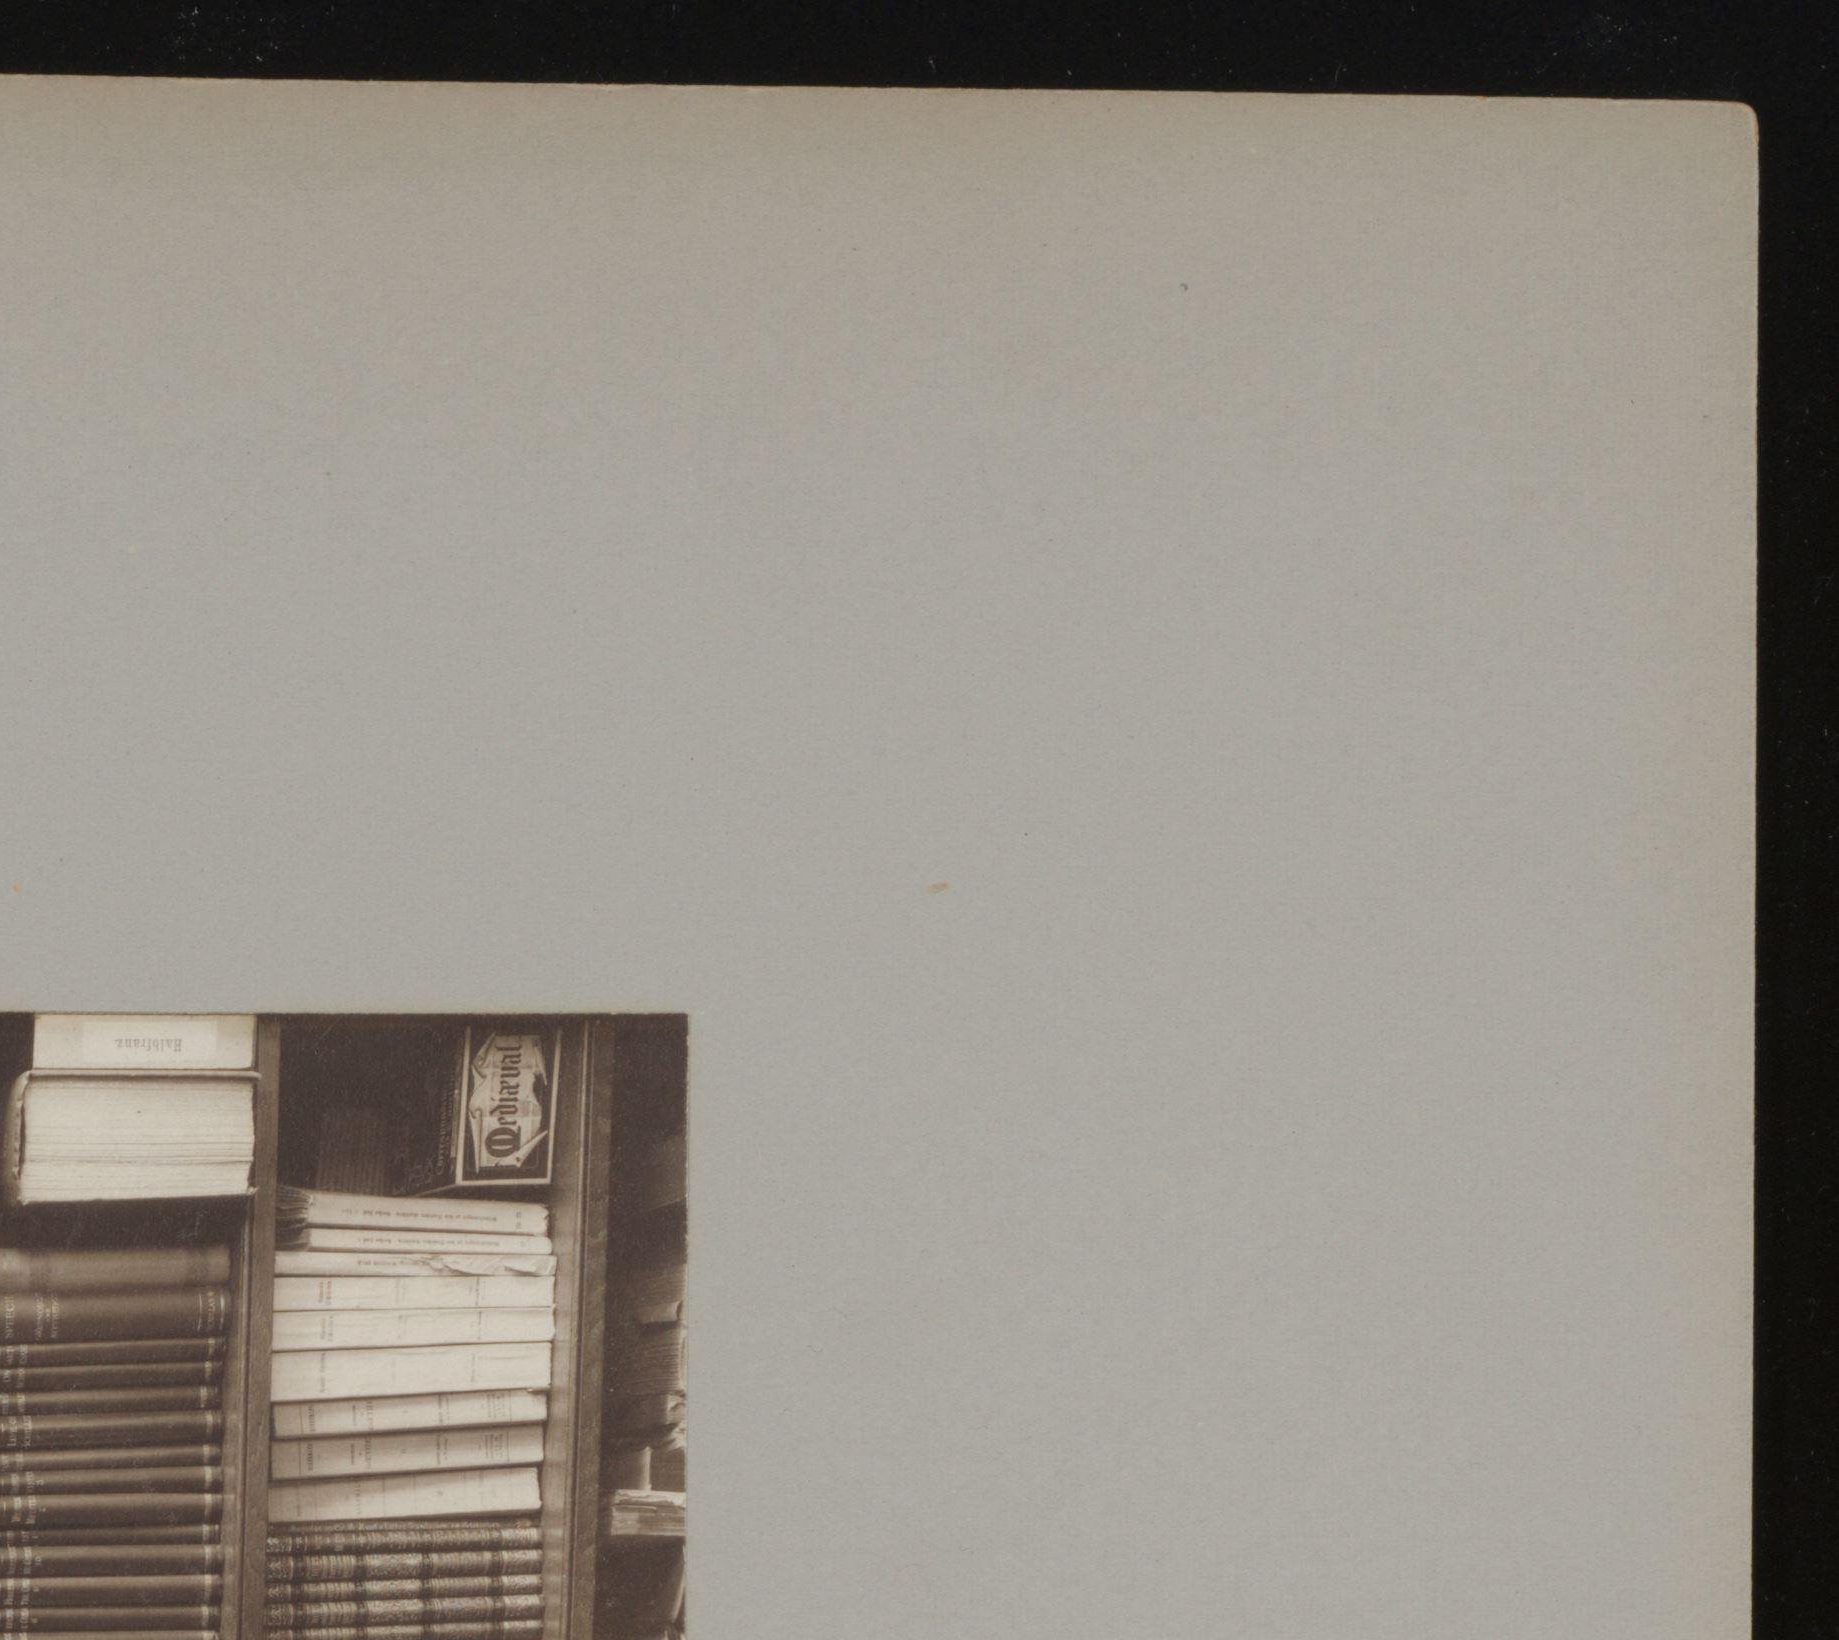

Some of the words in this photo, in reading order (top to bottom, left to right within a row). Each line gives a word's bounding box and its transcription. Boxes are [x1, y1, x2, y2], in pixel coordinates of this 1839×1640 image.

[114, 1038, 184, 1053] Halbfranz
[484, 1044, 523, 1158] Mediæval
[5, 1296, 15, 1339] SPEECH
